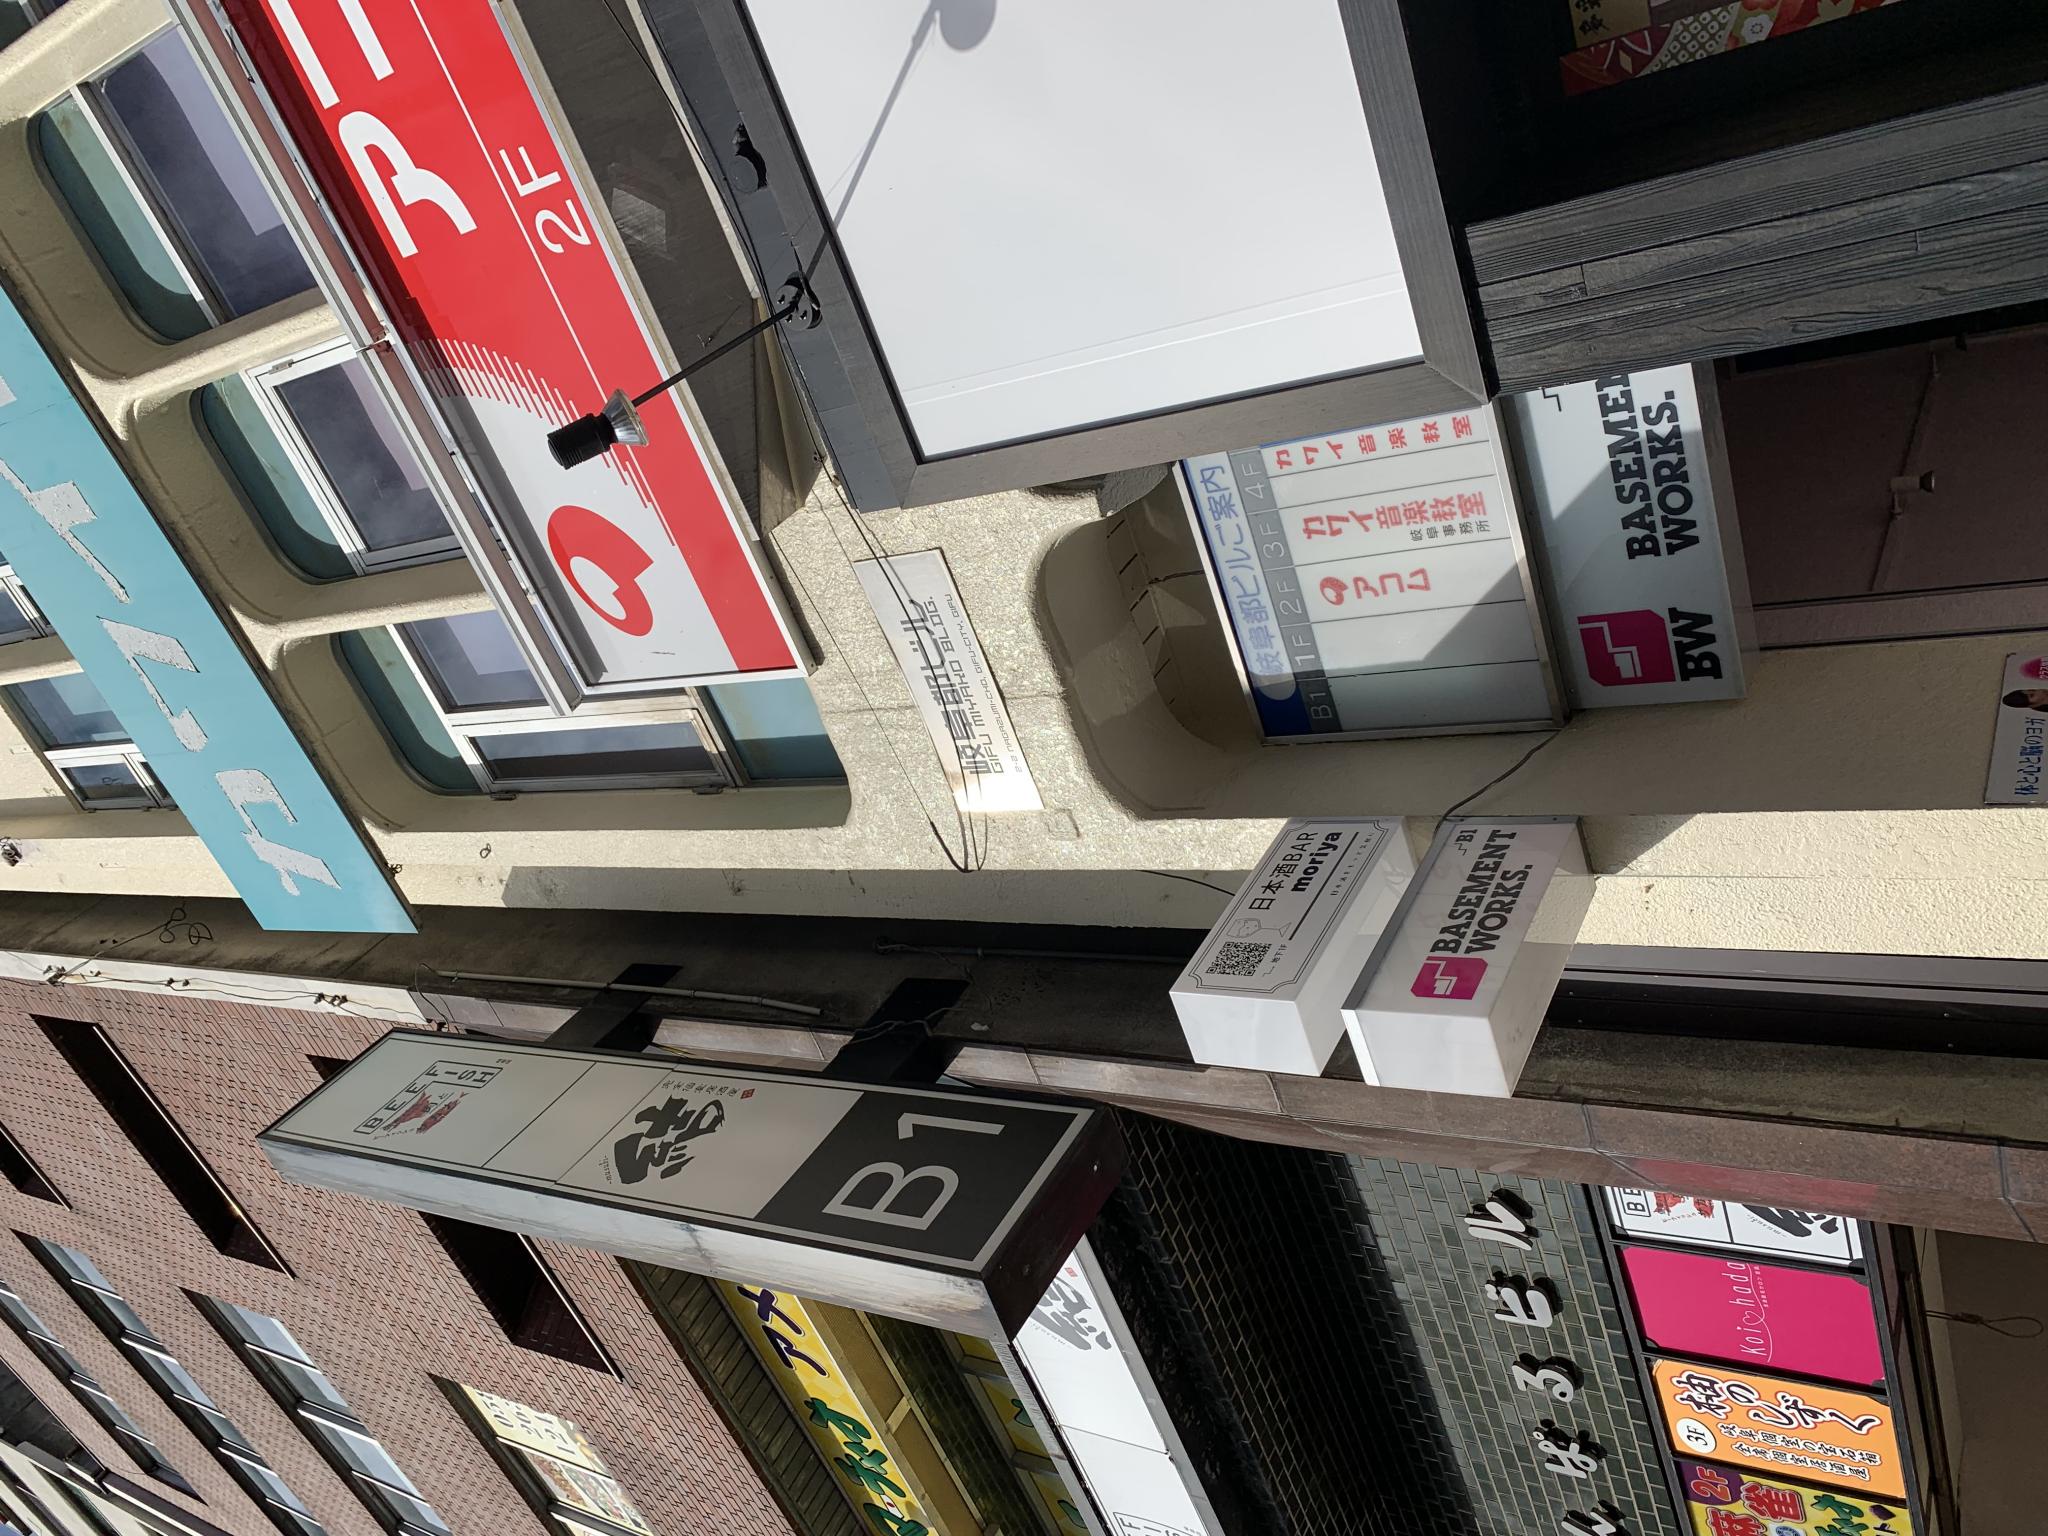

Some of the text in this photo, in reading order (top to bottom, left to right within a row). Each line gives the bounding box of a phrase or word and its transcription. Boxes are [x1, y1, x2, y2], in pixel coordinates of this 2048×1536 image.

[499, 146, 591, 253] 2F
[1276, 415, 1473, 469] カワイ音楽教室
[1642, 390, 1700, 555] WORKS.
[1302, 492, 1487, 540] カワイ音楽教室
[1410, 520, 1491, 541] 岐阜事務所
[1199, 465, 1284, 673] 岐阜都ビルご案内
[1241, 462, 1332, 719] B1 1F 2F 3F 4F
[1353, 568, 1431, 599] アコム
[1668, 608, 1723, 681] BW
[900, 599, 992, 774] 岐阜都ビル
[950, 660, 985, 727] MIYAKO
[979, 734, 1004, 773] GIFU
[2014, 716, 2046, 795] 体と心と脳のヨガ
[1290, 831, 1343, 892] moriya
[1455, 829, 1478, 843] B1
[1248, 832, 1318, 910] 日本酒BAR
[1430, 829, 1517, 953] BASEMENT
[1464, 865, 1533, 954] WORKS.
[822, 1113, 1005, 1231] B1
[1676, 1373, 1877, 1431] 柚のしずく
[1686, 1426, 1708, 1446] 3F
[1719, 1424, 1878, 1464] 岐阜個室の宝石箱
[1734, 1443, 1868, 1479] 全席個室居酒屋
[1691, 1466, 1732, 1501] 2F
